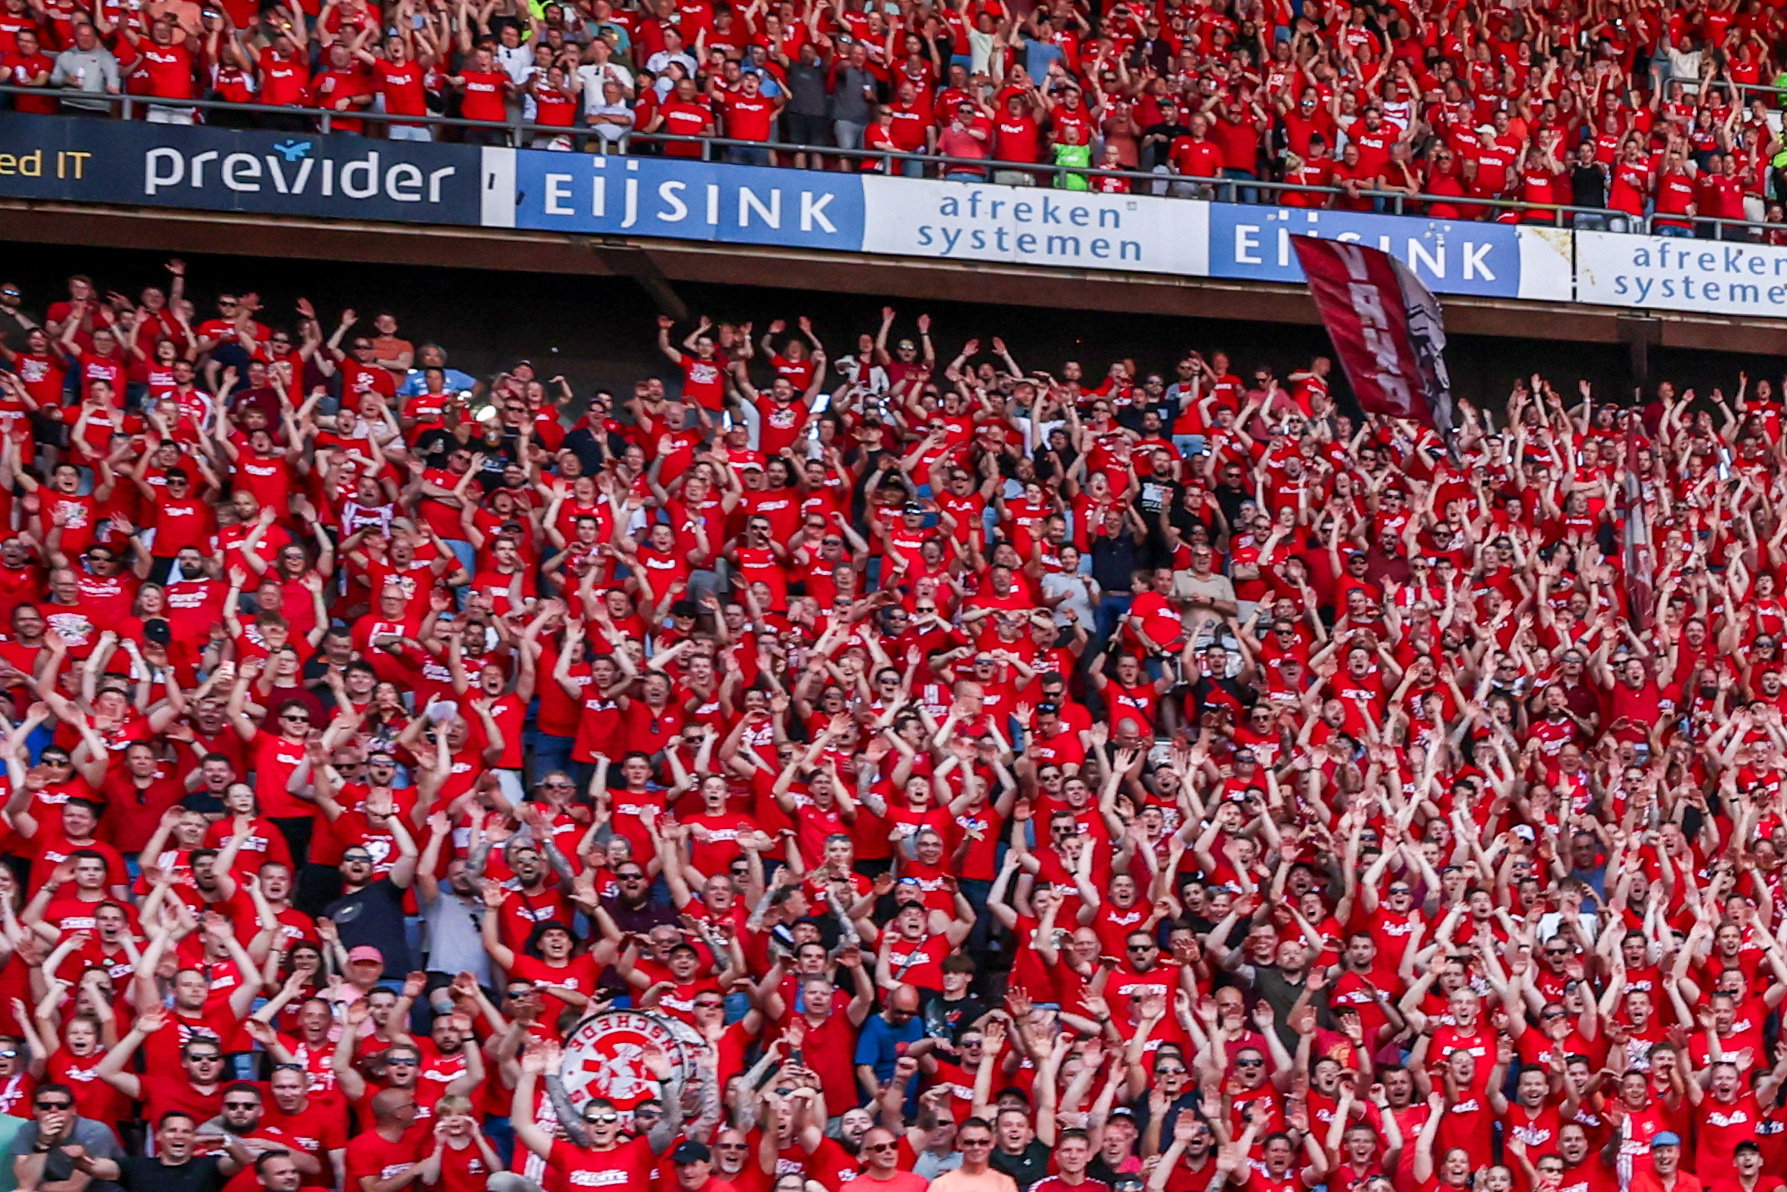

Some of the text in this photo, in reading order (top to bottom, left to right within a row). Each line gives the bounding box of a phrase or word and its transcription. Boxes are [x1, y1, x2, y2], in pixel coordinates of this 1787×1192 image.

[57, 150, 92, 179] IT
[144, 147, 456, 203] previder
[939, 190, 1121, 229] afreken
[917, 224, 1142, 262] systemen
